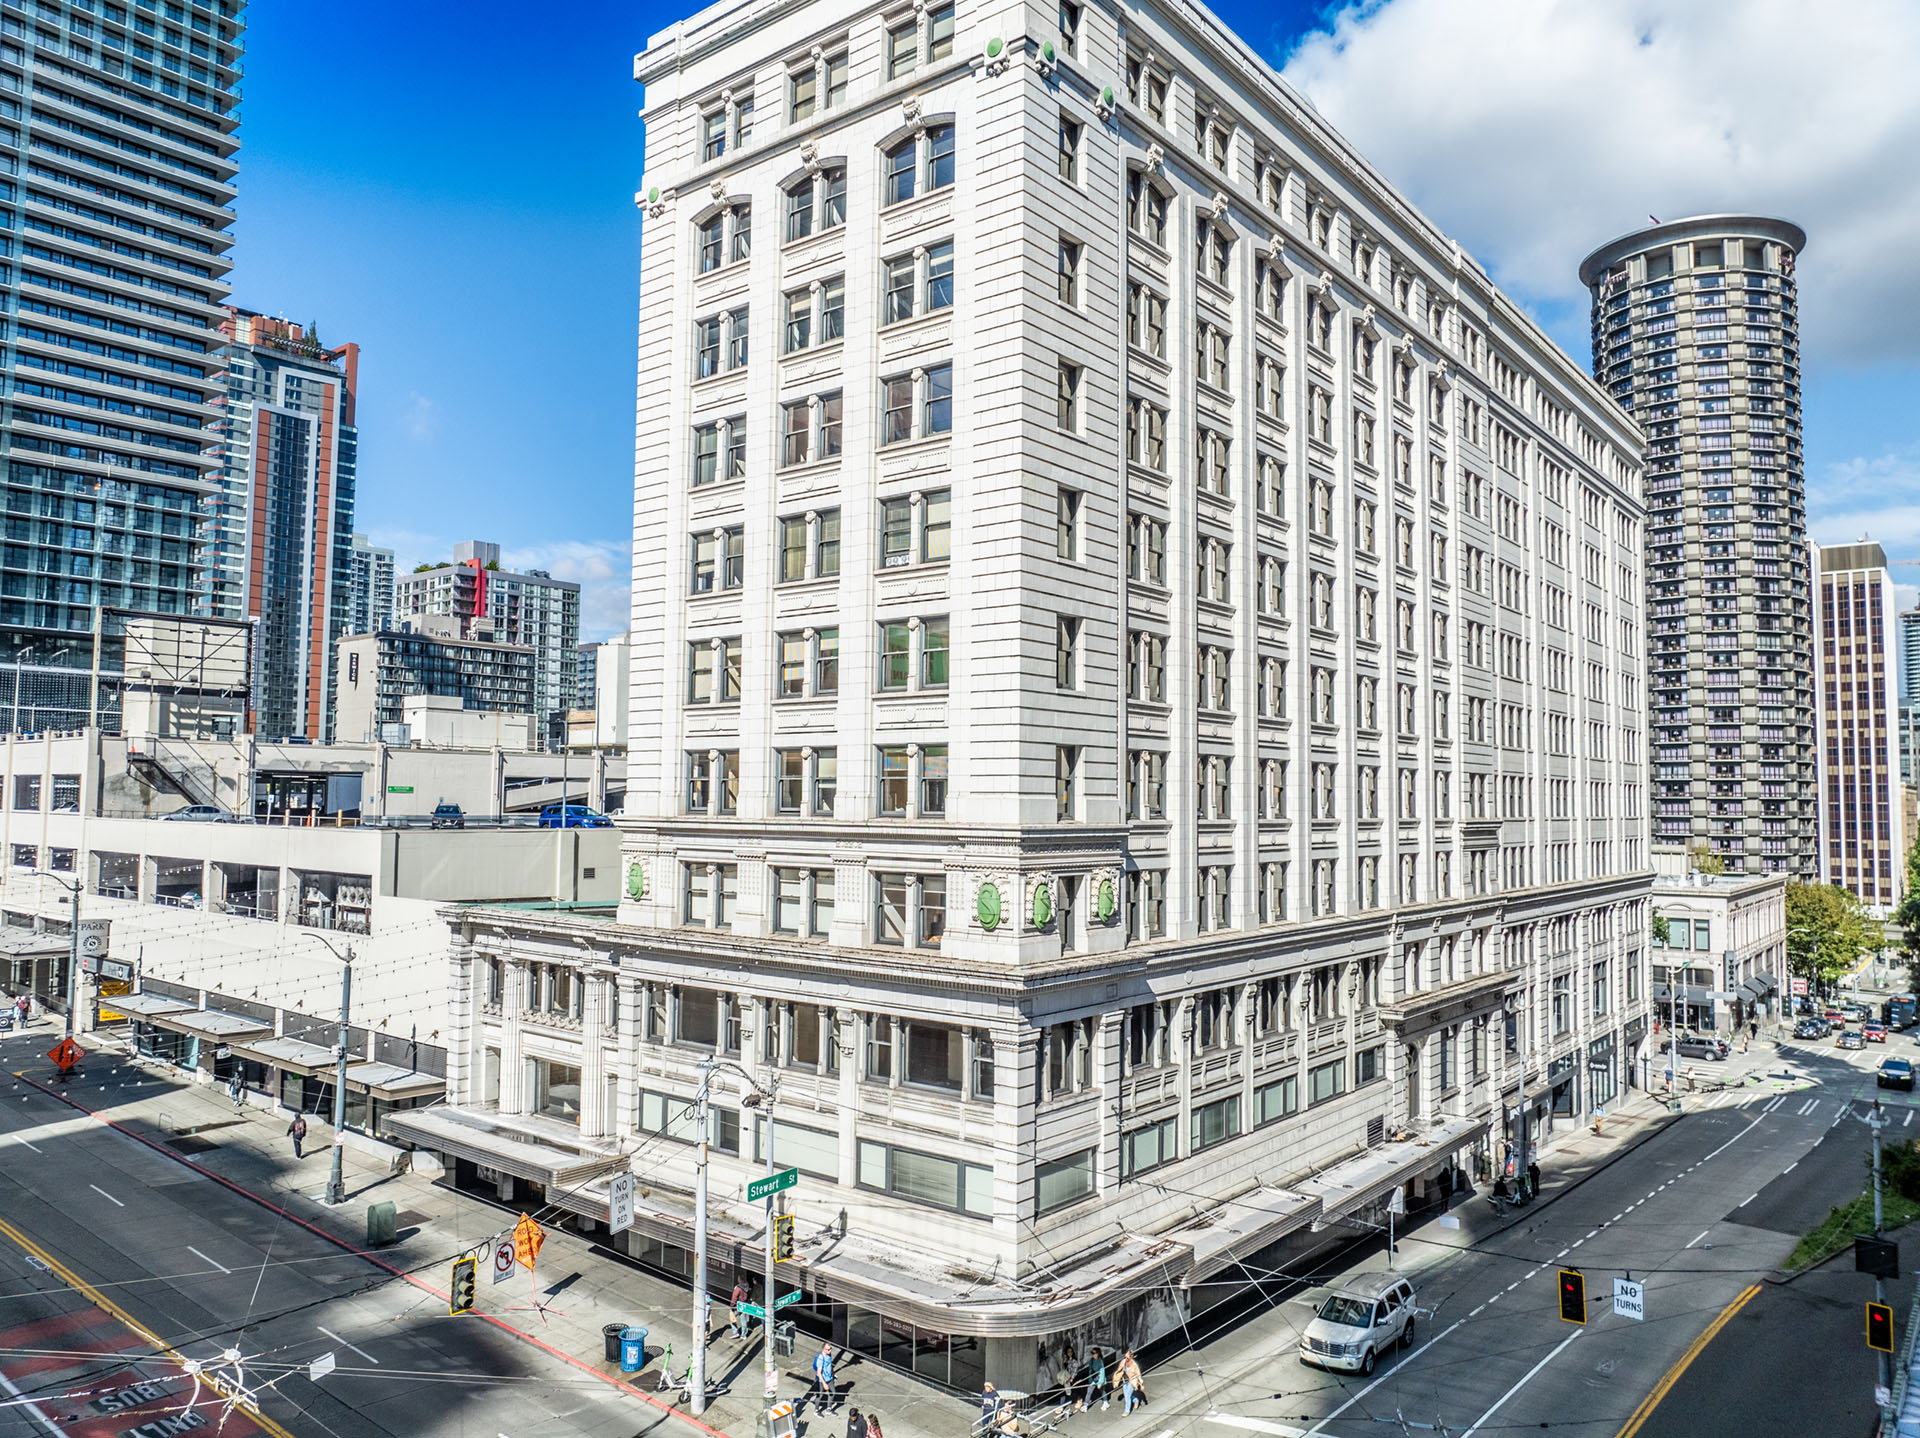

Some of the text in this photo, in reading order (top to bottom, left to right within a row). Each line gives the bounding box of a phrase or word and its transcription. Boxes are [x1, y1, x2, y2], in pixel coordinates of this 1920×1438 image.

[81, 922, 104, 930] PARK
[616, 1180, 627, 1193] NO
[750, 1174, 795, 1197] Stewart St
[615, 1192, 629, 1204] TURN
[618, 1204, 626, 1214] ON
[617, 1214, 628, 1225] RED
[1621, 1285, 1637, 1297] NO
[1616, 1298, 1642, 1313] TURNS
[98, 1384, 159, 1412] BUS
